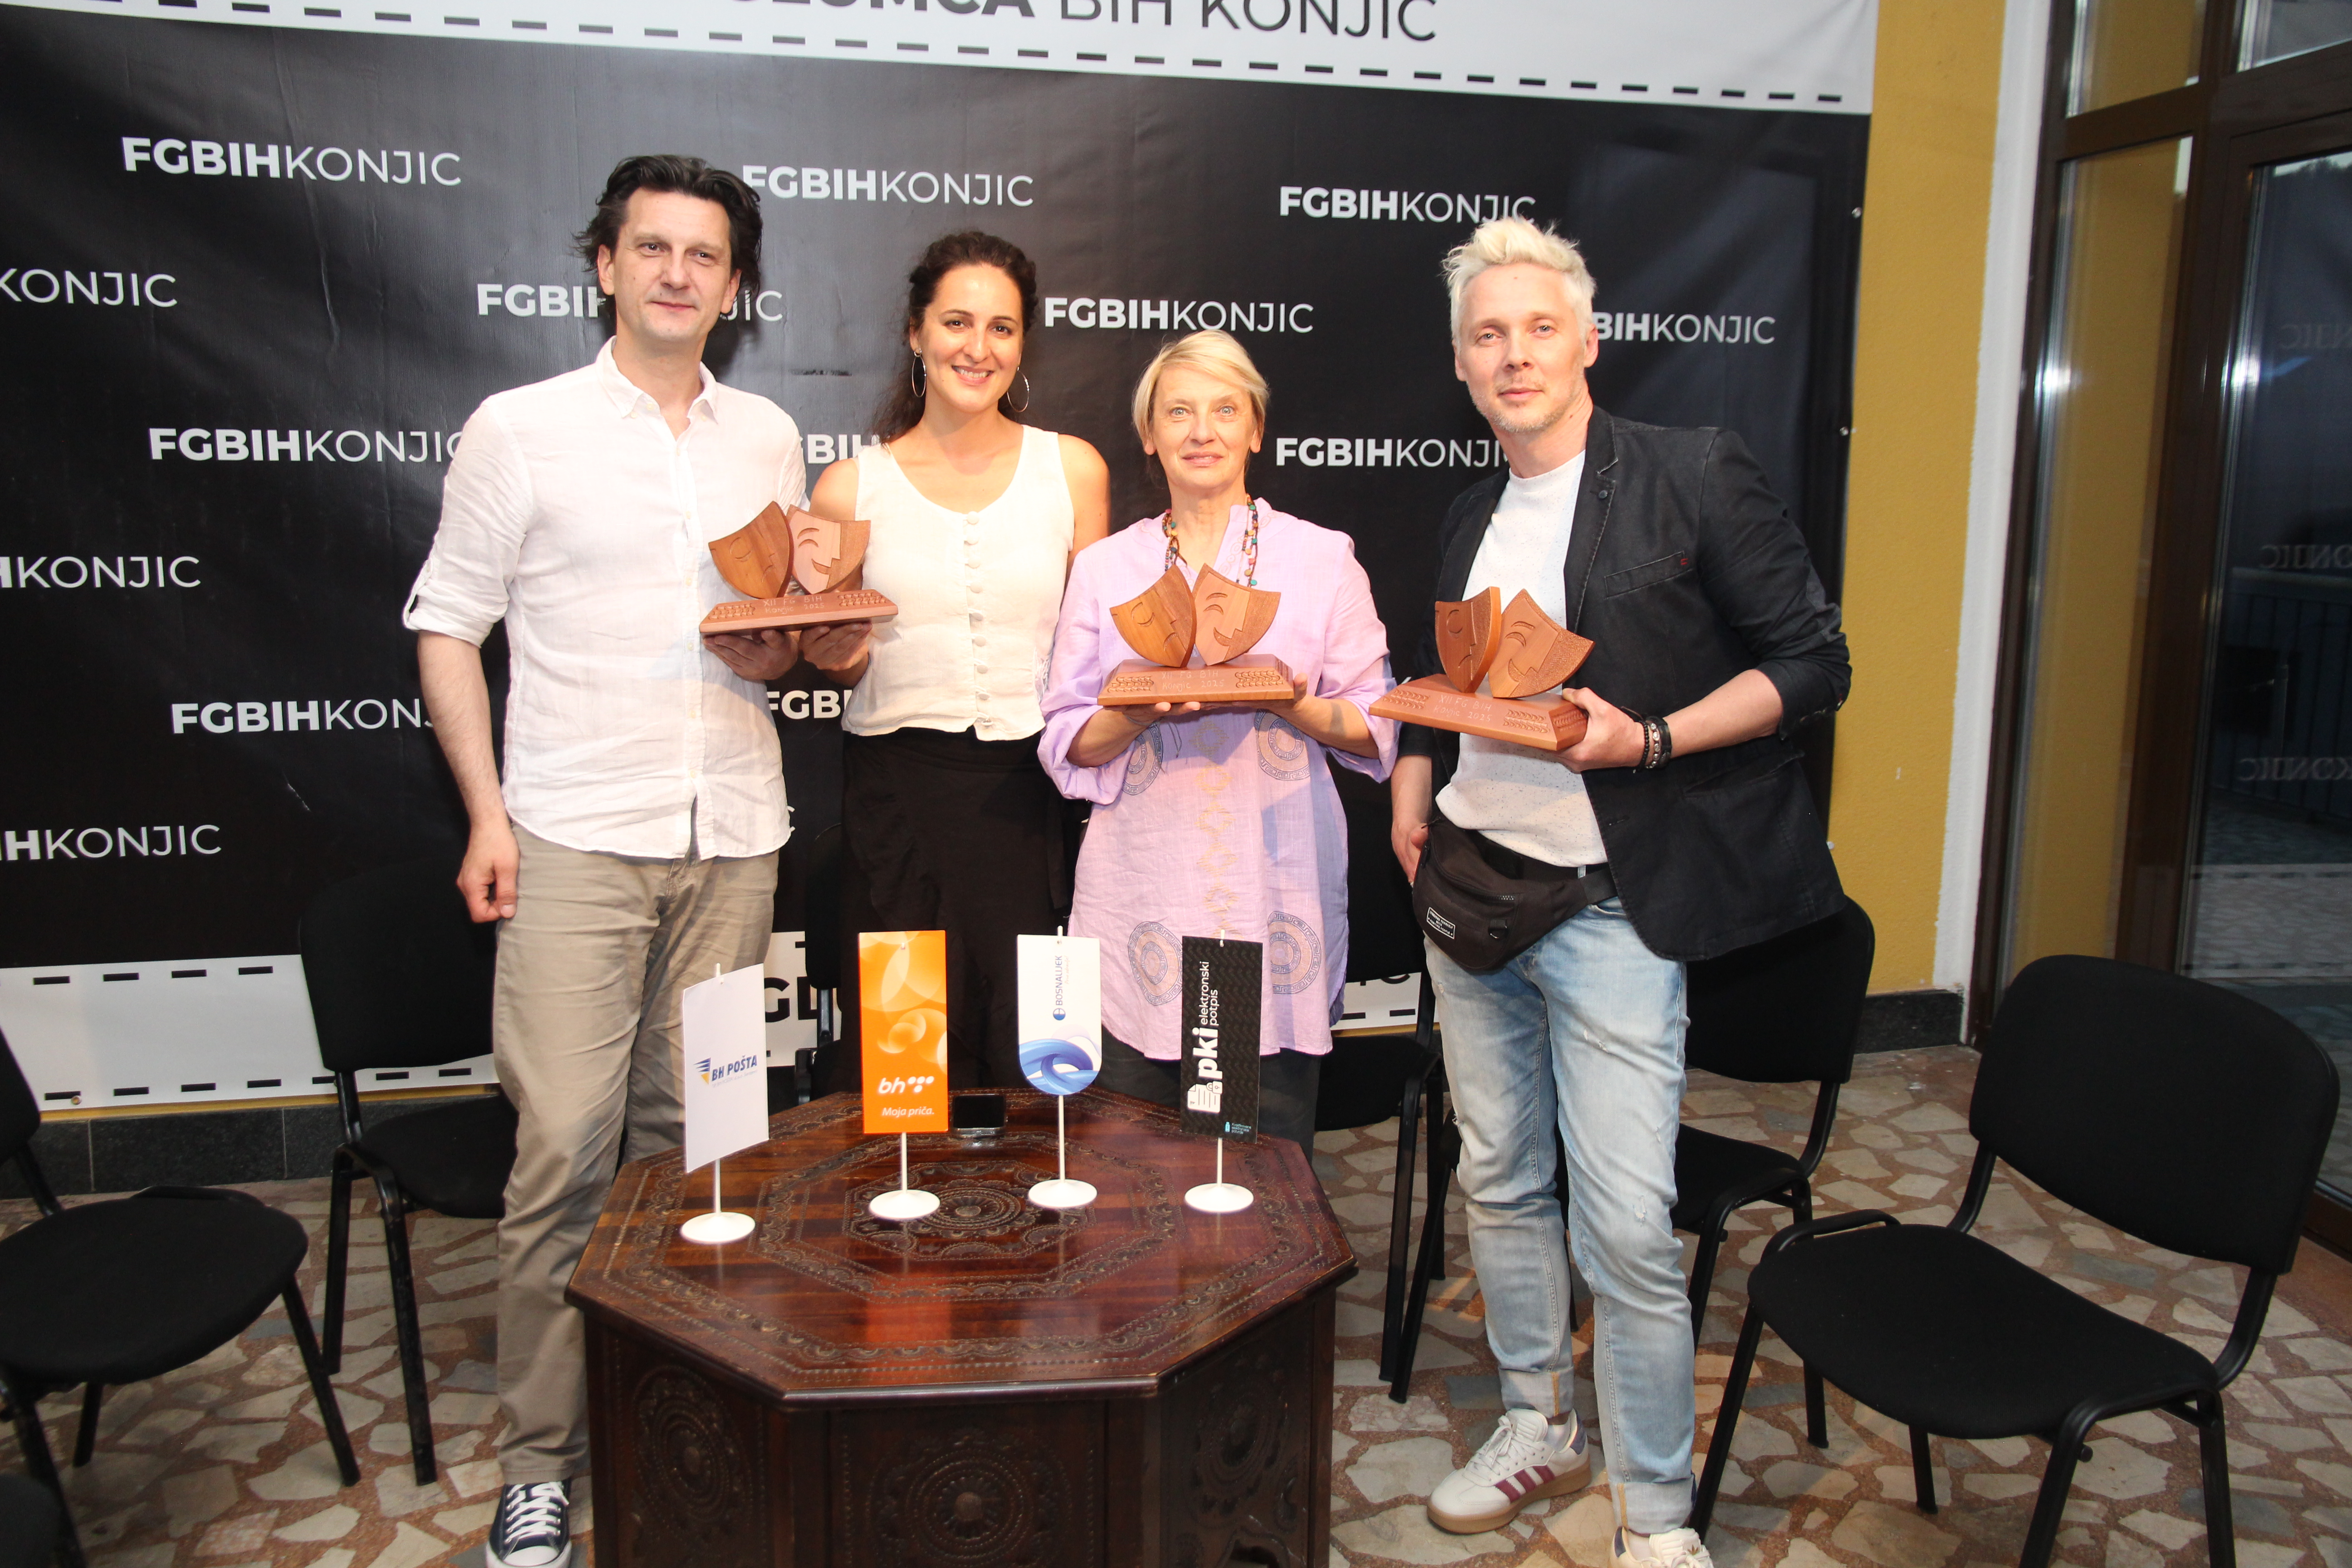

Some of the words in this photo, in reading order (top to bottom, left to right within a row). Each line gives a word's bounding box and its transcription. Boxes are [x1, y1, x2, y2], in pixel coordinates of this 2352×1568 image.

[1202, 0, 1436, 41] KONJIC
[122, 137, 461, 186] FGBIHKONJIC
[743, 165, 1033, 206] FGBIHKONJIC
[1045, 297, 1313, 333] FGBIHKONJIC
[1276, 437, 1508, 467] FGBIHKONJI
[1468, 711, 1493, 722] 2025
[0, 824, 221, 861] HKONJIC
[1199, 961, 1210, 1025] elektronski
[1208, 989, 1220, 1026] potpis
[711, 1065, 725, 1082] BH
[727, 1054, 758, 1076] POŠTA
[1191, 1027, 1223, 1080] pki
[882, 1107, 906, 1118] Moja
[908, 1106, 935, 1117] priča.
